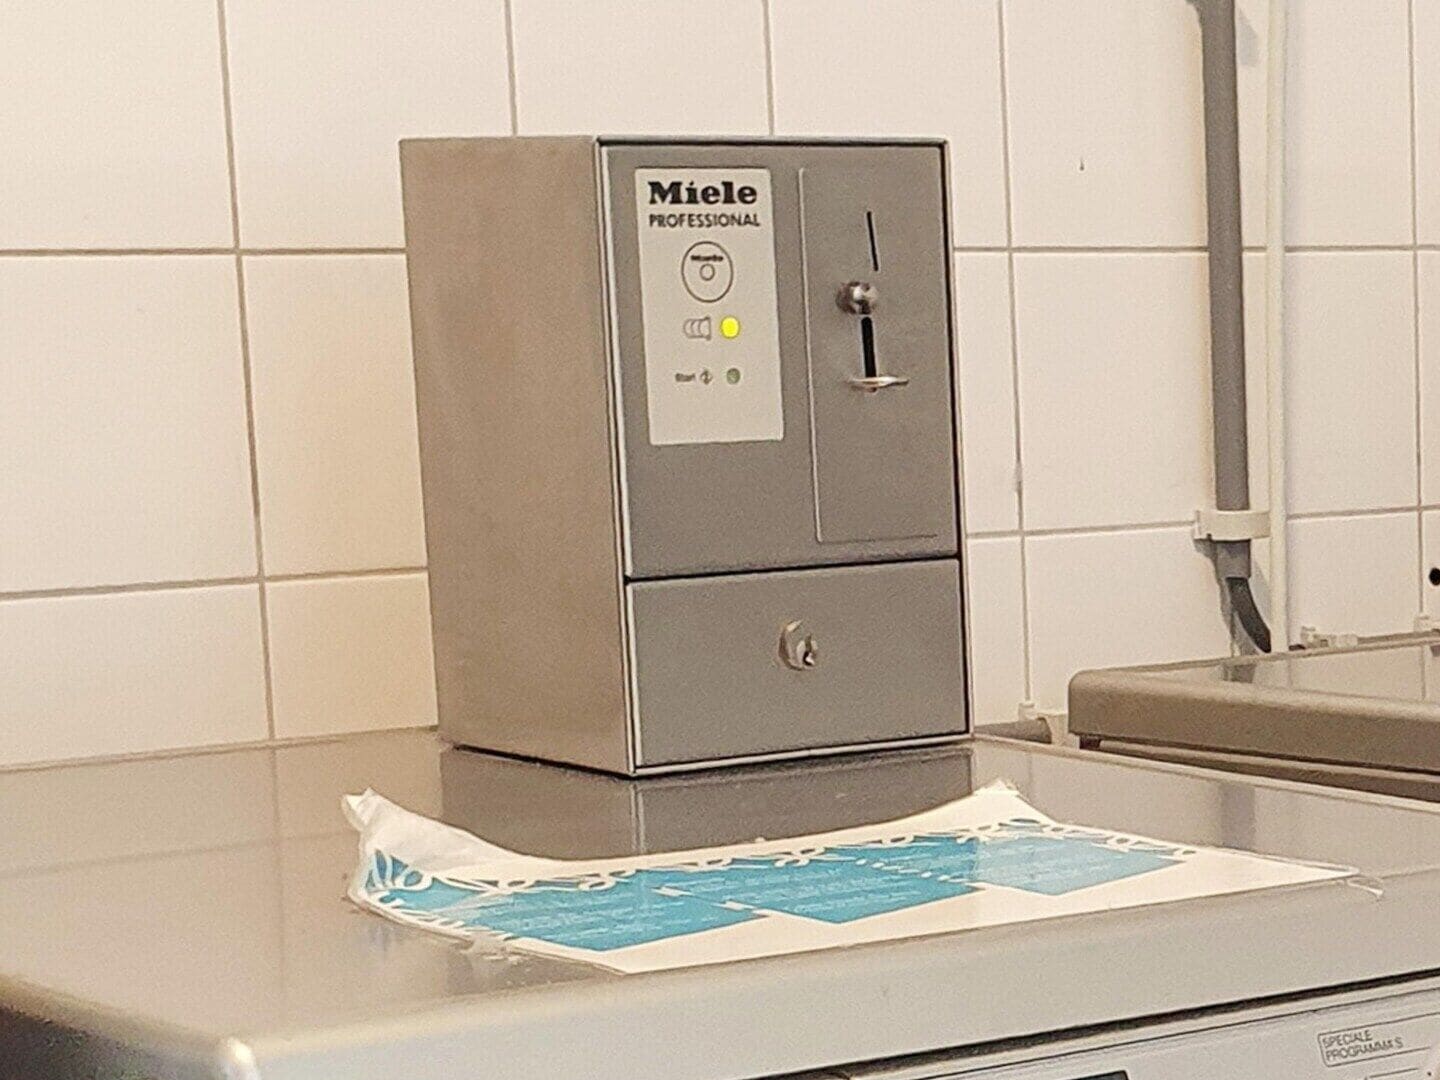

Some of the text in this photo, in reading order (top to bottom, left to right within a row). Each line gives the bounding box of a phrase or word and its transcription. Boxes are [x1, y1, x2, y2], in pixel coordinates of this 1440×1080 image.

[647, 181, 757, 205] Miele
[649, 213, 760, 227] PROFESSIONAL
[1322, 1029, 1373, 1048] SPECIALE
